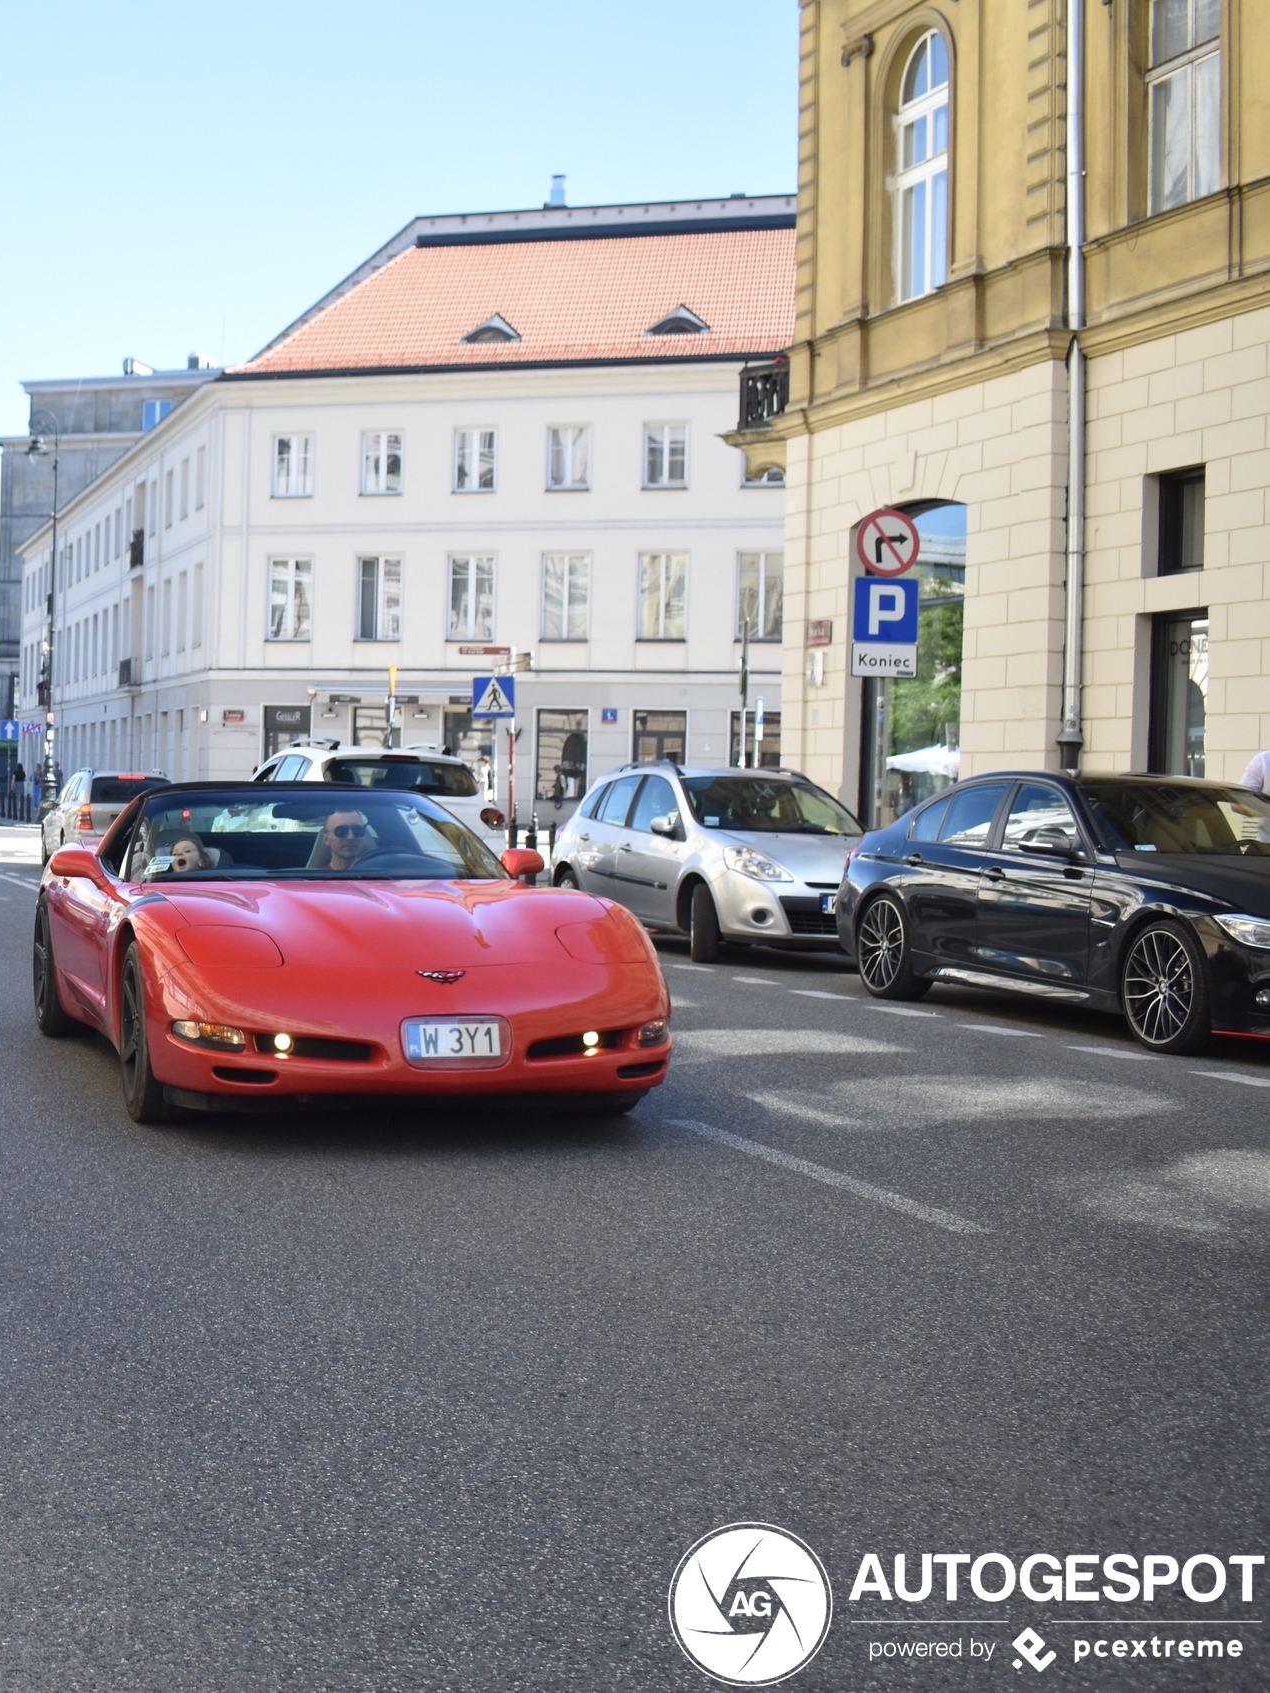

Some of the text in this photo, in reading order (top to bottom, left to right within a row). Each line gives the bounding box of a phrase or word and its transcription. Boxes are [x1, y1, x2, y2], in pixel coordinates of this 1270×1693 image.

[868, 584, 906, 635] P
[858, 653, 910, 668] Koniec
[22, 724, 43, 734] TAXI
[422, 1027, 493, 1054] W 3Y1
[410, 1045, 420, 1053] PL
